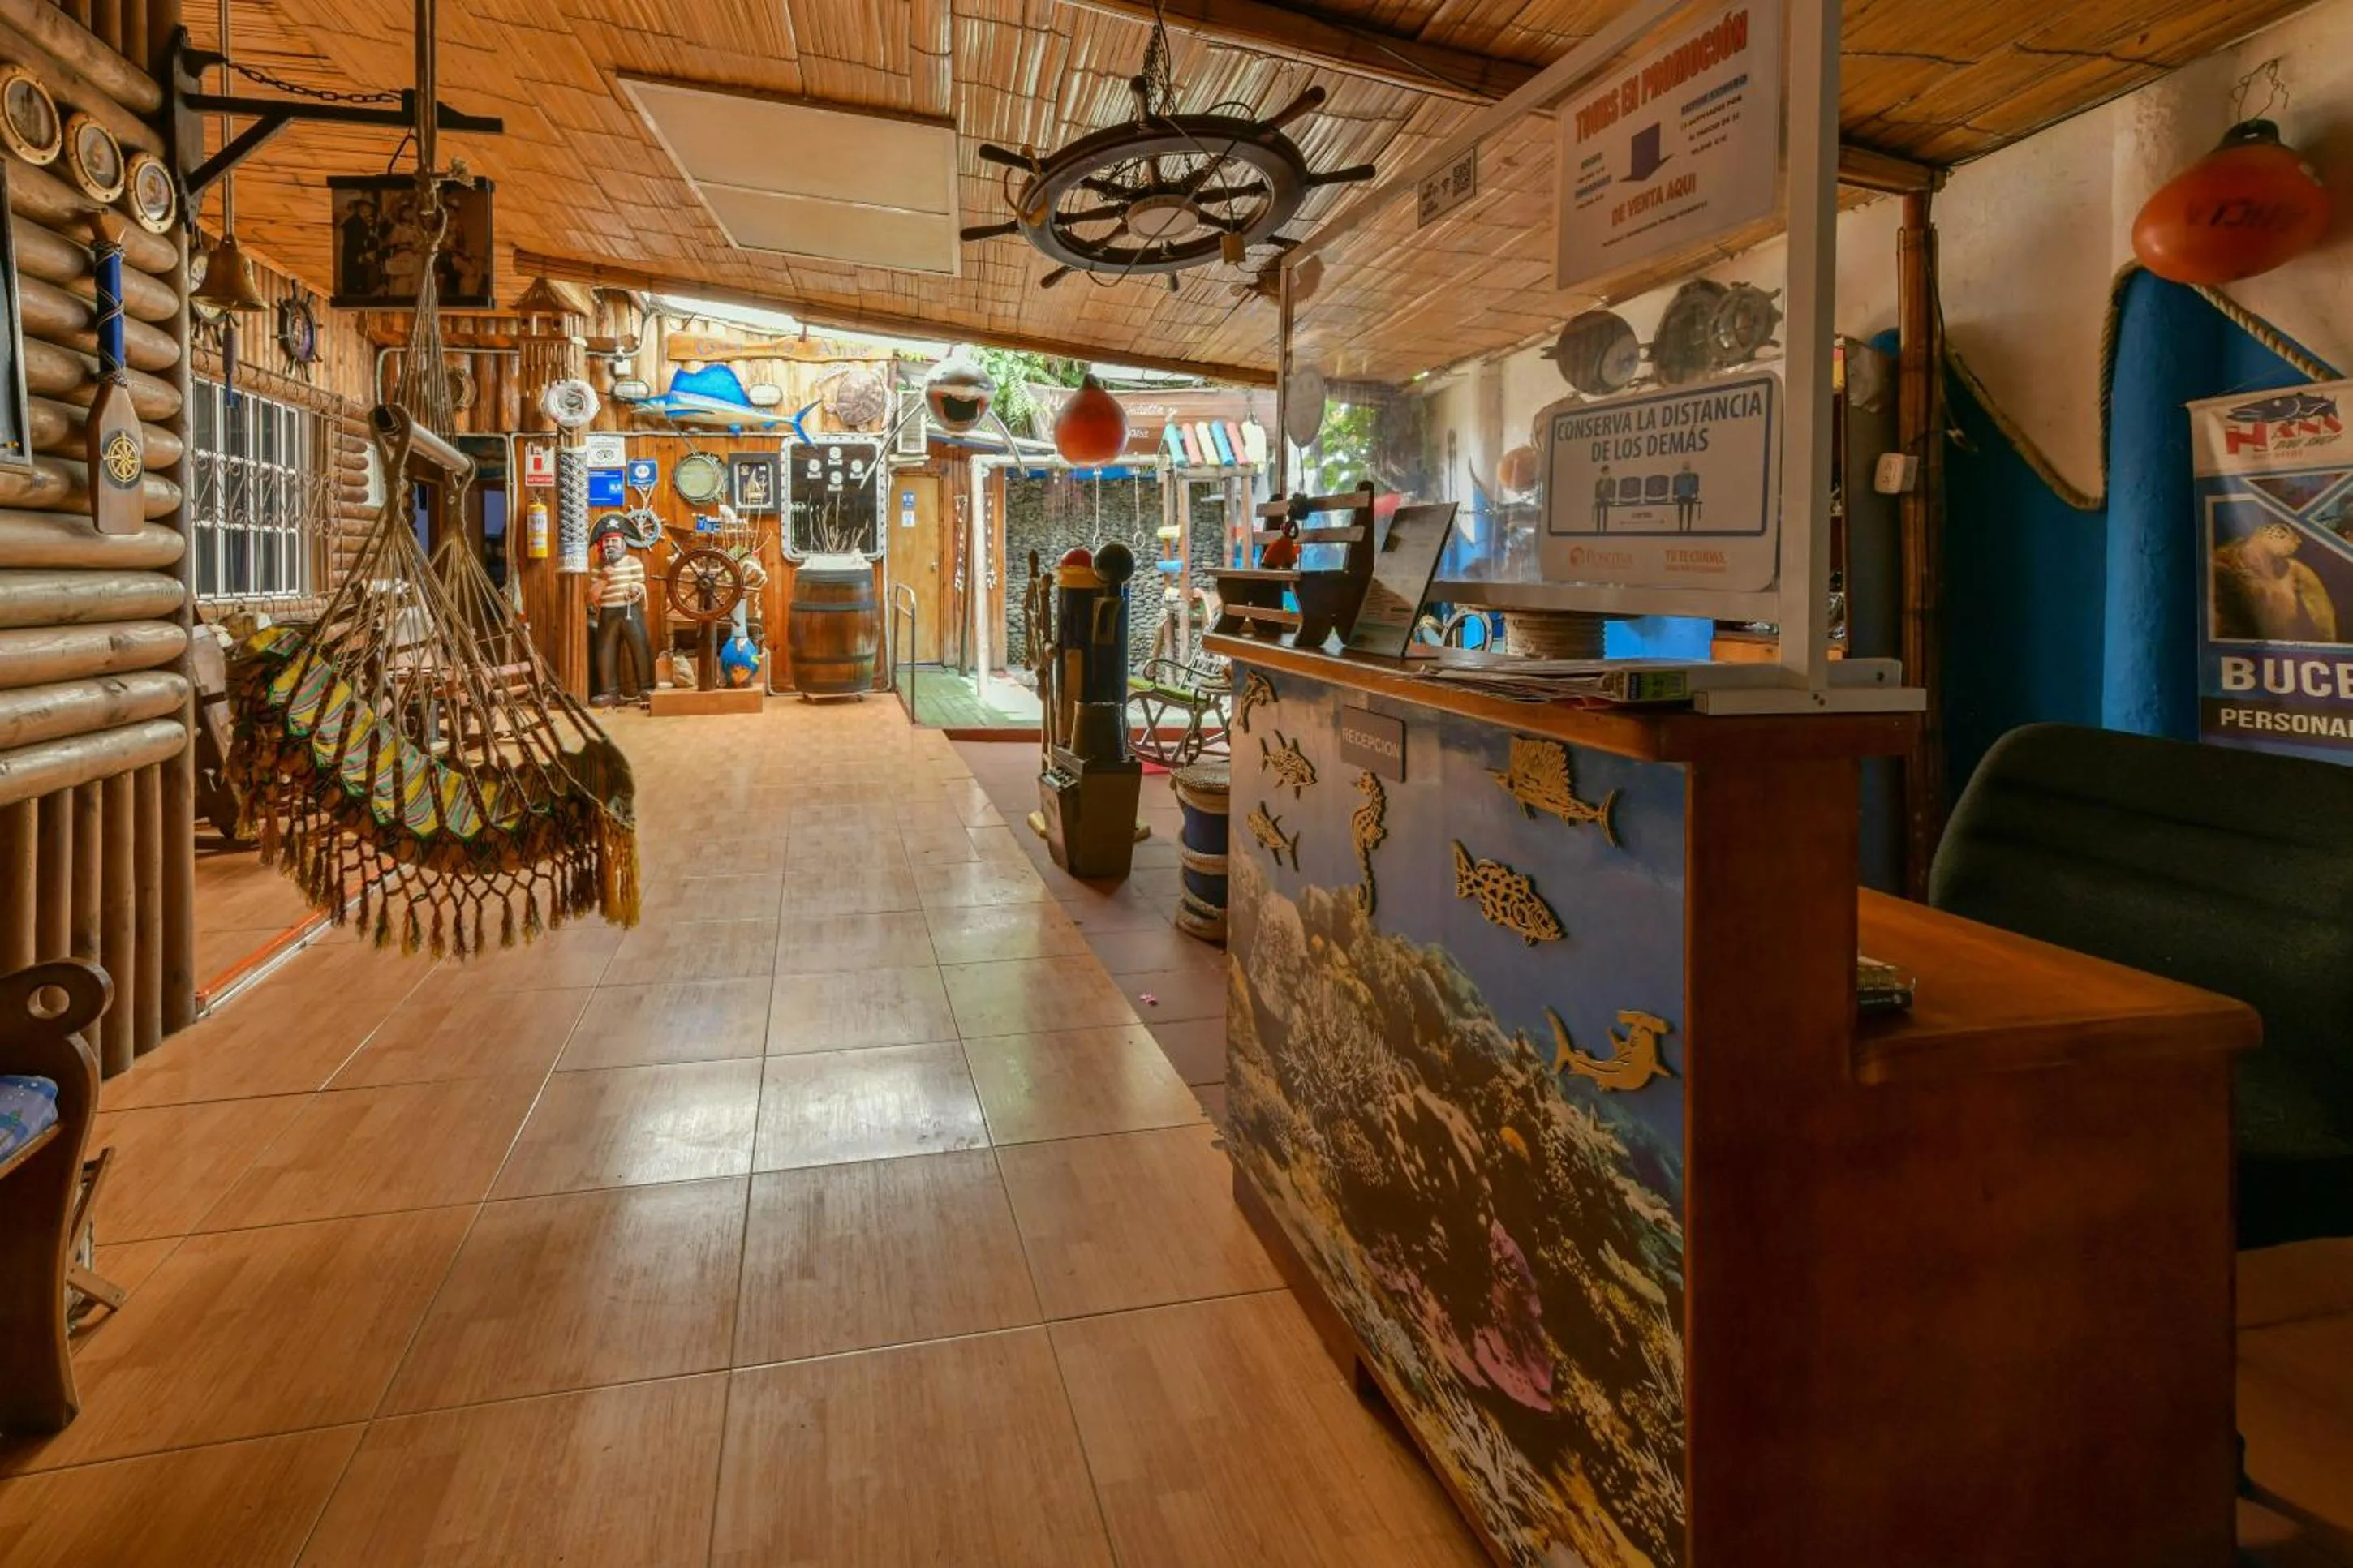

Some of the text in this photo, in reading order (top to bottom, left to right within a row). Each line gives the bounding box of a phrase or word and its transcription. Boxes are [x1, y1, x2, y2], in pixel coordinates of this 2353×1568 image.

[1621, 75, 1639, 118] EN
[1627, 184, 1663, 217] VENTA
[1557, 391, 1762, 441] CONSERVA LA DISTANCIA
[1591, 424, 1710, 462] DE LOS DEMÁS
[2220, 707, 2353, 739] PERSONA
